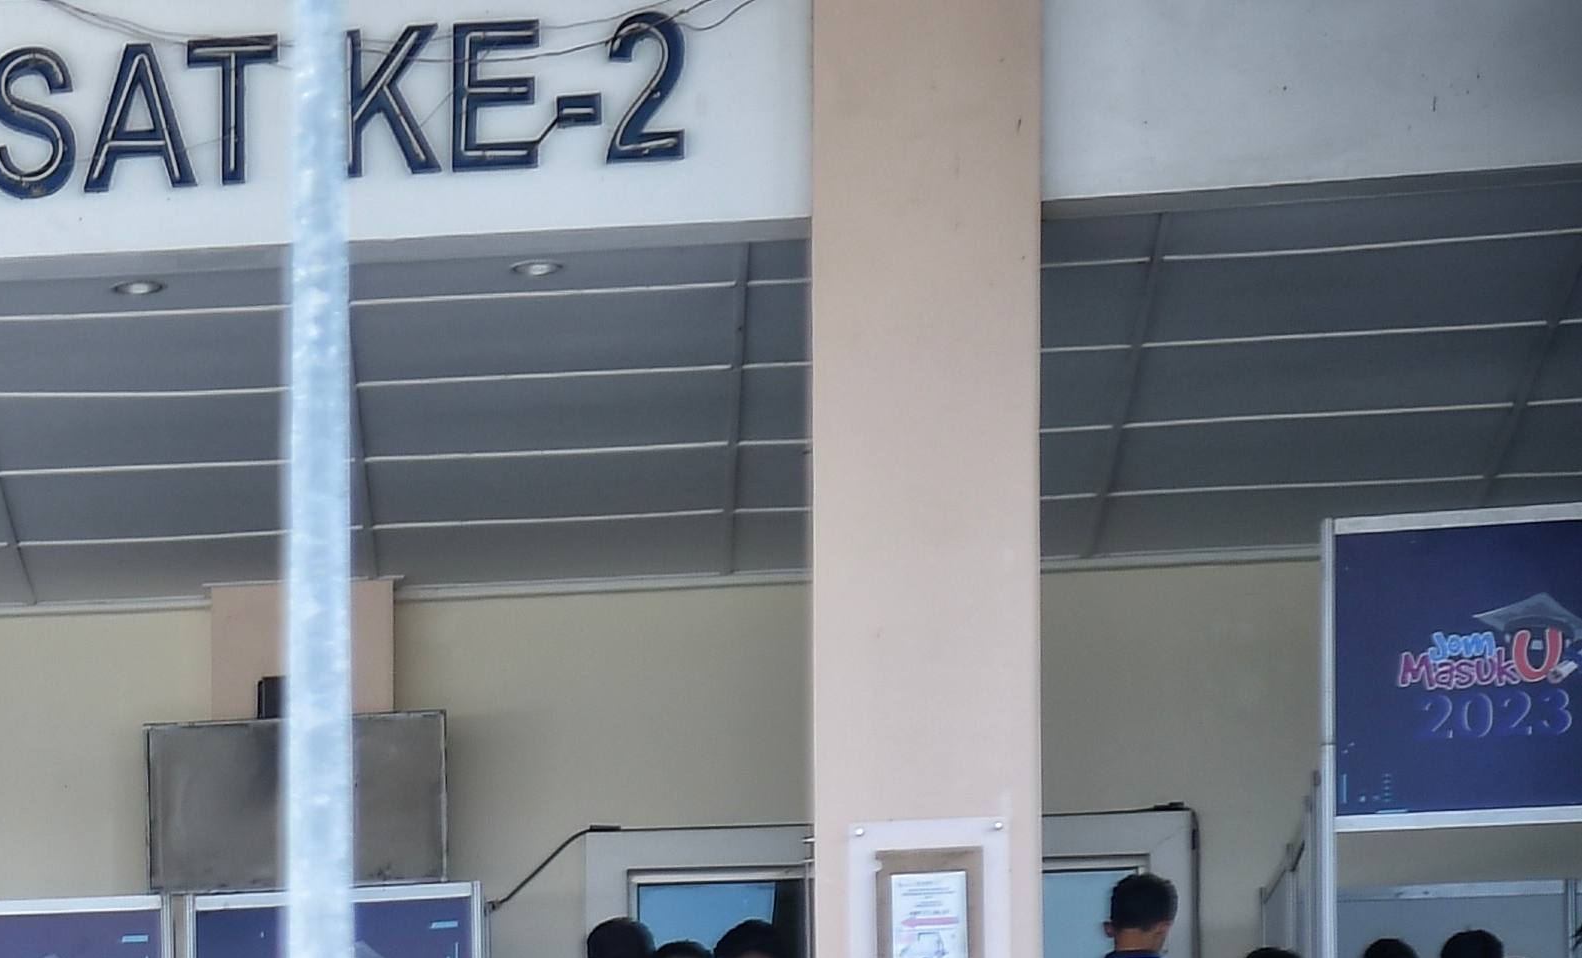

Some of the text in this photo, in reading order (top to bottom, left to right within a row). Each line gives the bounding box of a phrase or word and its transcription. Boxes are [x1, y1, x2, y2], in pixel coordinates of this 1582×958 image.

[345, 11, 686, 178] KE-2
[1427, 630, 1496, 662] Jom
[1415, 688, 1573, 740] 2023
